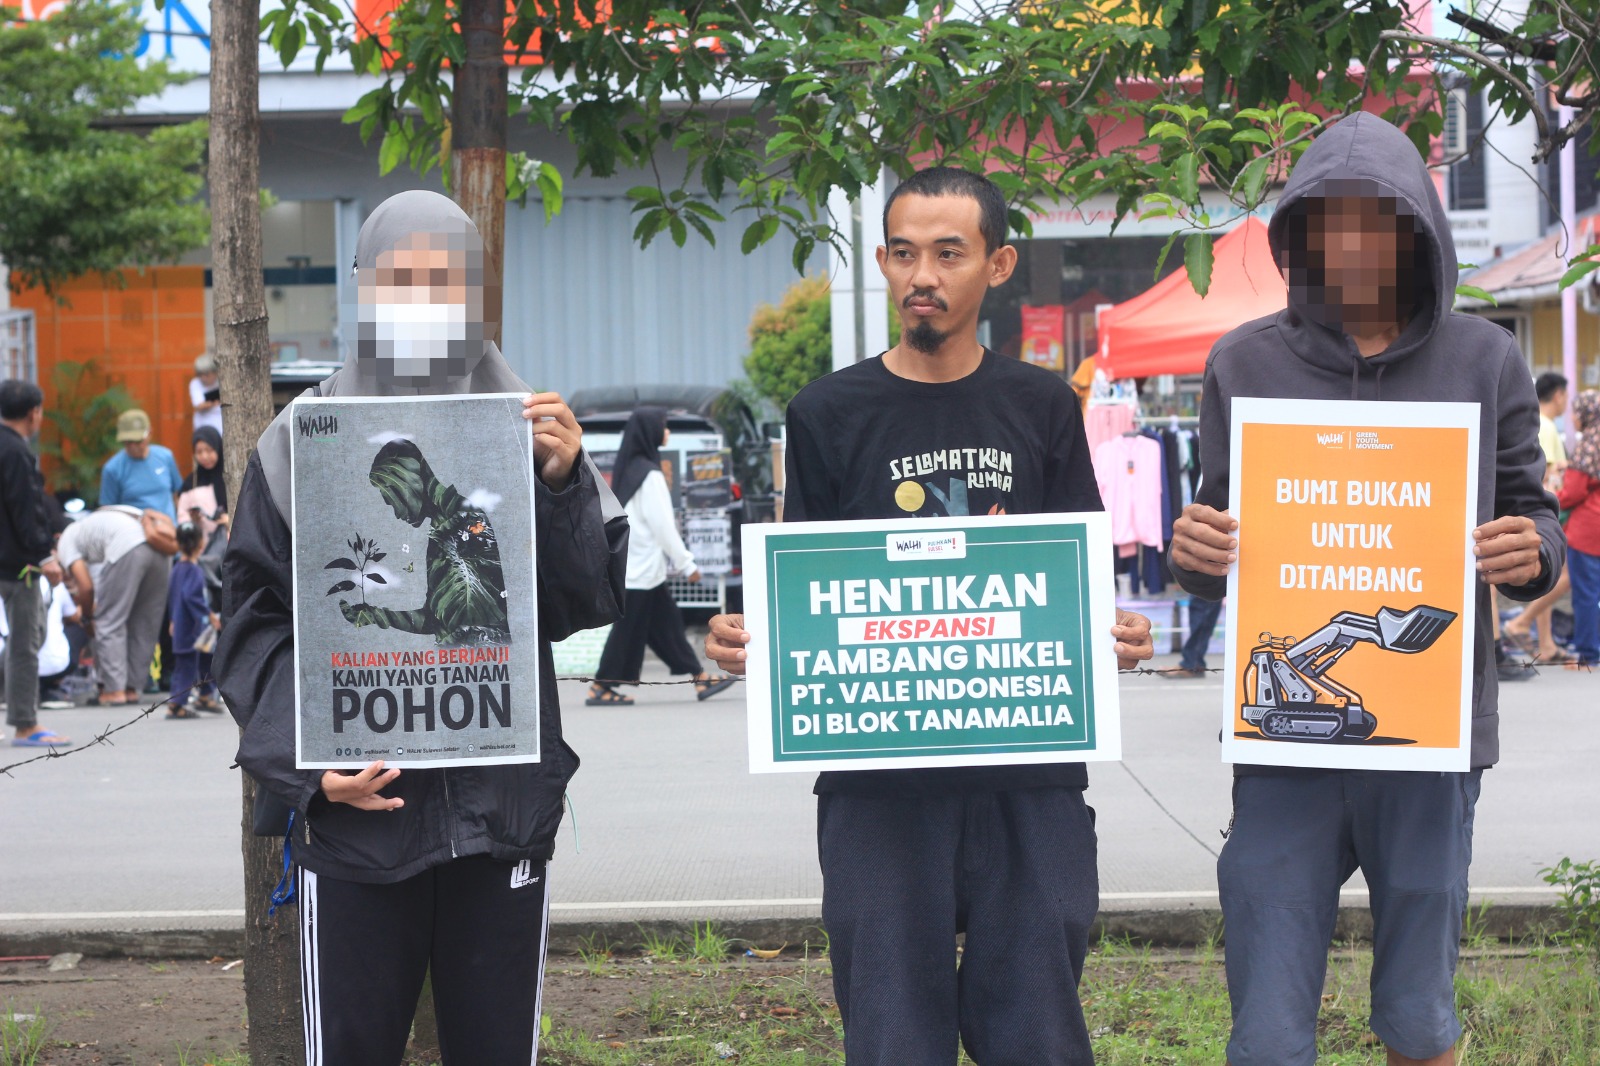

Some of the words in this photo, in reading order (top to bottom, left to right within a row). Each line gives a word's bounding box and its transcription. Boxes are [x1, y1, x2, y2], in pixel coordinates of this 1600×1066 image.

[298, 414, 338, 440] WALHI
[1316, 431, 1343, 446] WALHI
[889, 447, 1013, 481] SELAMATKAN
[967, 471, 1013, 493] RIMBA
[1276, 478, 1338, 505] BUMI
[1346, 480, 1431, 508] BUKAN
[896, 540, 922, 552] WALHI
[1311, 521, 1393, 550] UNTUK
[1279, 563, 1423, 593] DITAMBANG
[809, 572, 1048, 615] HENTIKAN
[863, 616, 996, 641] EKSPANSI
[331, 651, 389, 668] KALIAN
[391, 649, 436, 667] YANG
[438, 646, 510, 665] BERJANJI
[790, 644, 969, 677] TAMBANG
[975, 640, 1073, 670] NIKEL
[332, 669, 381, 688] KAMI
[384, 668, 437, 687] YANG
[439, 663, 510, 684] TANAM
[791, 683, 834, 706] PT.
[838, 679, 911, 704] VALE
[915, 674, 1074, 701] INDONESIA
[332, 682, 512, 734] POHON
[791, 713, 820, 736] DI
[826, 710, 900, 735] BLOK
[904, 704, 1075, 732] TANAMALIA
